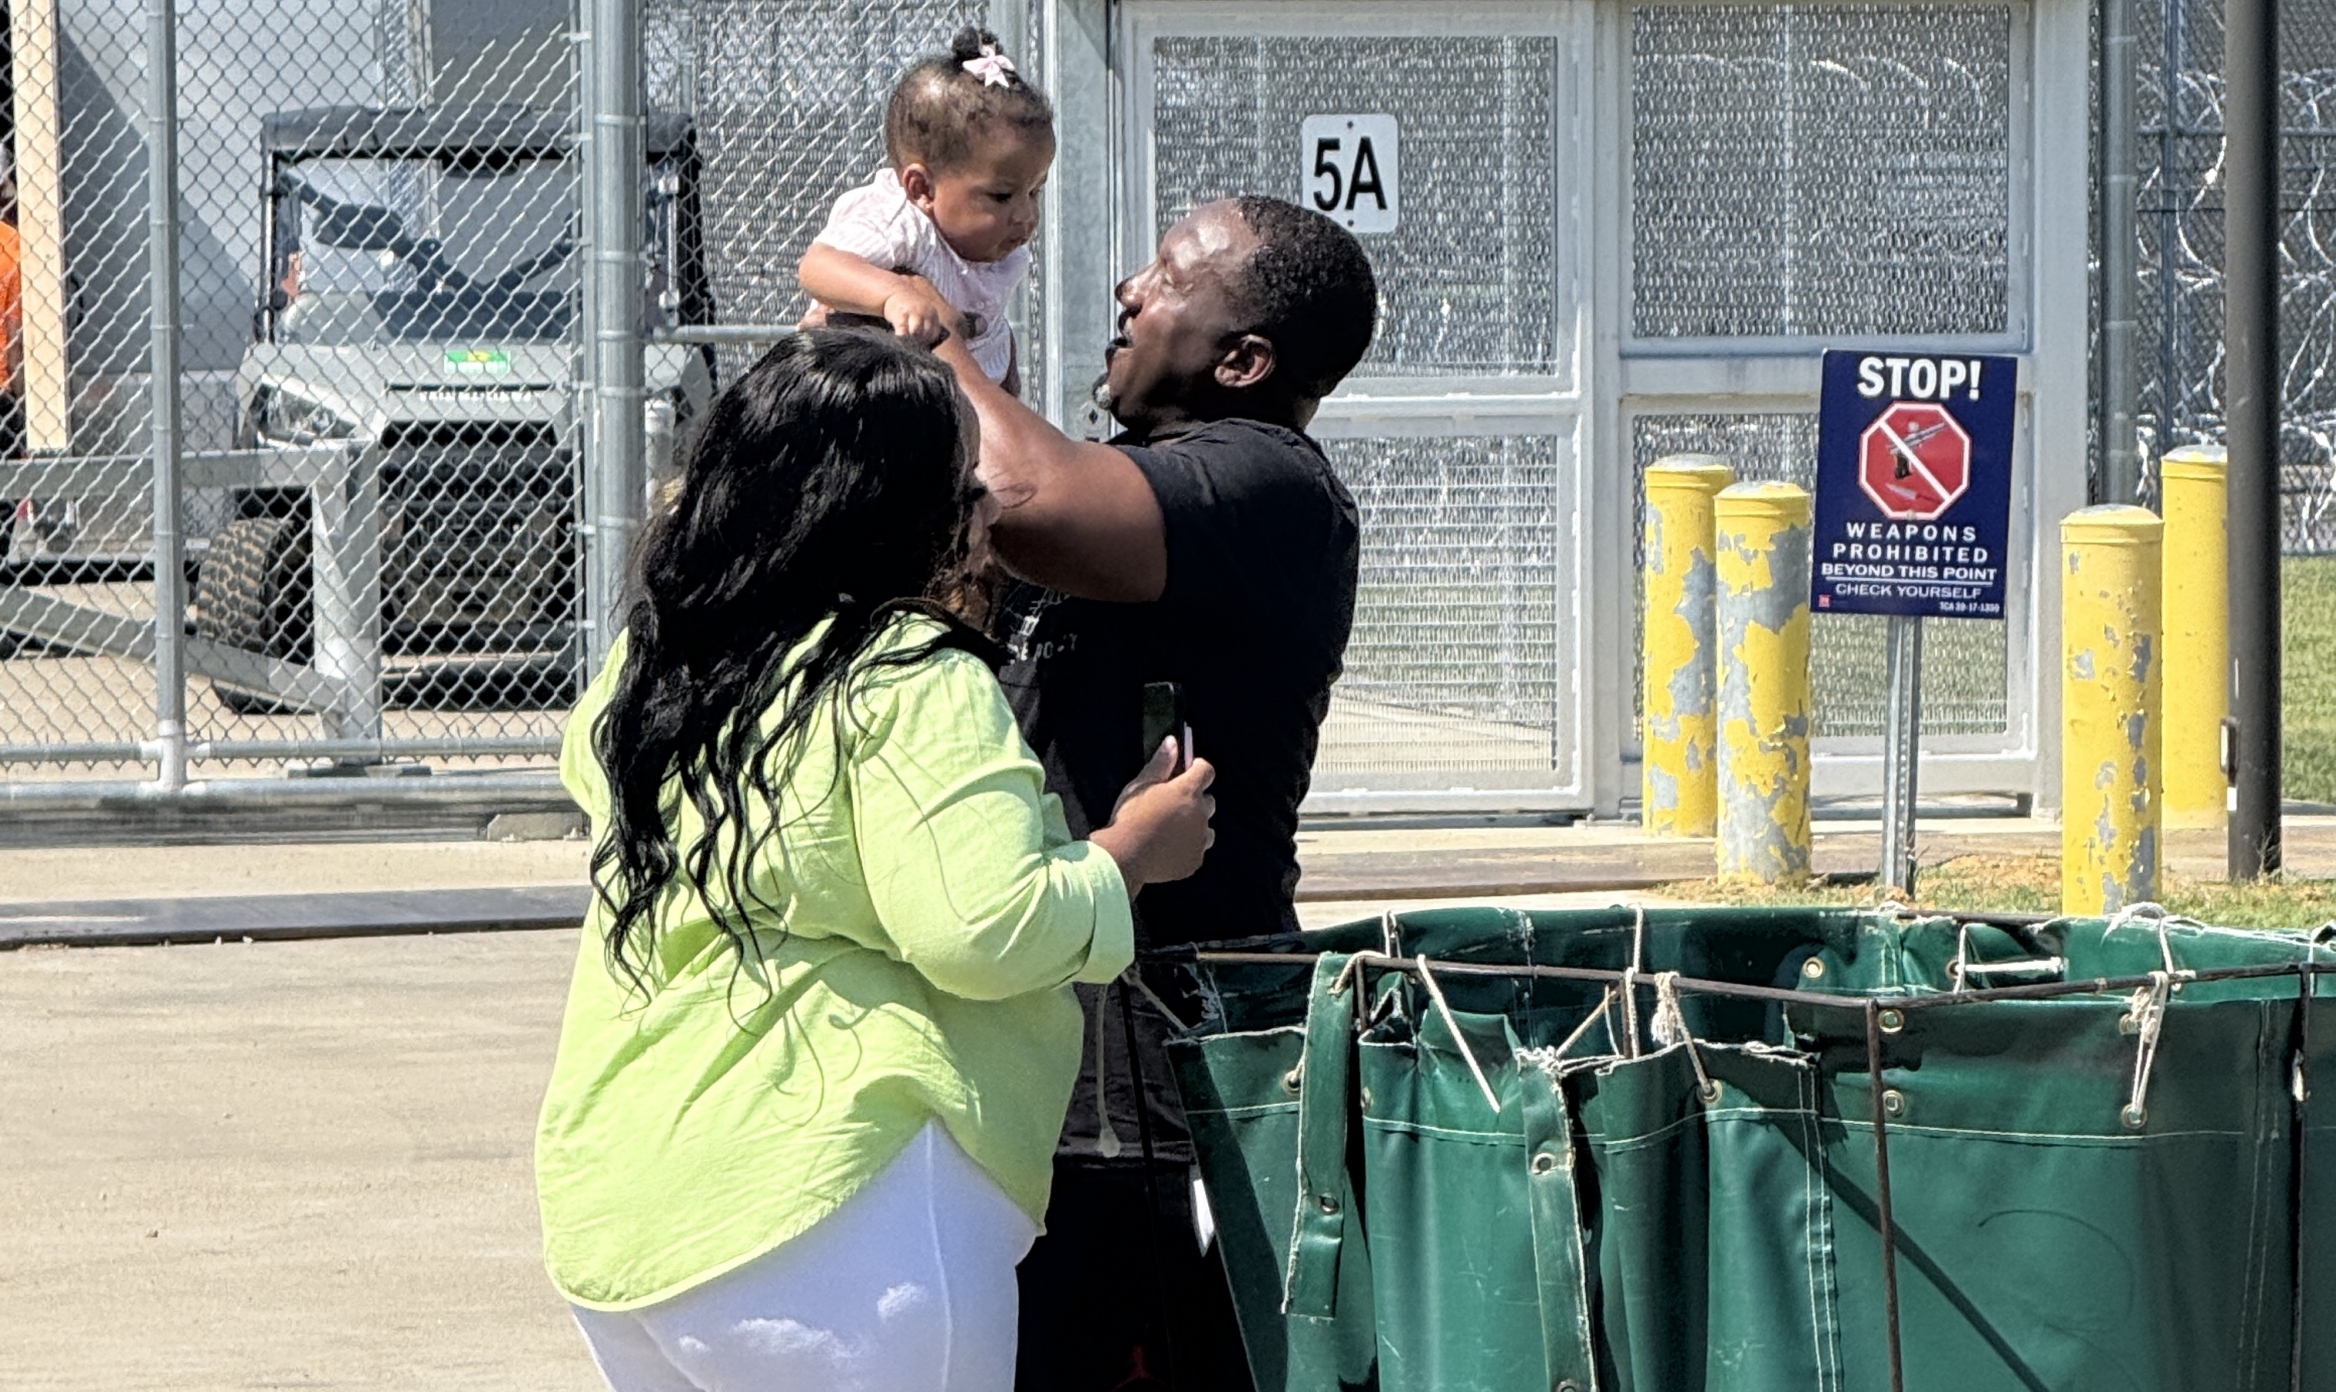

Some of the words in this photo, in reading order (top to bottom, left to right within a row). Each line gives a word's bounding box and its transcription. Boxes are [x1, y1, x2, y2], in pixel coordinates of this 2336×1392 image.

[1313, 136, 1387, 211] 5A
[1857, 357, 1982, 400] STOP!
[1846, 522, 1977, 542] WEAPONS
[1832, 543, 1988, 563] PROHIBITED
[1821, 563, 1894, 577] BEYOND
[1899, 565, 1938, 578] THIS
[1942, 567, 1997, 580] POINT
[1835, 583, 1892, 596] CHECK
[1897, 585, 1982, 599] YOURSELF
